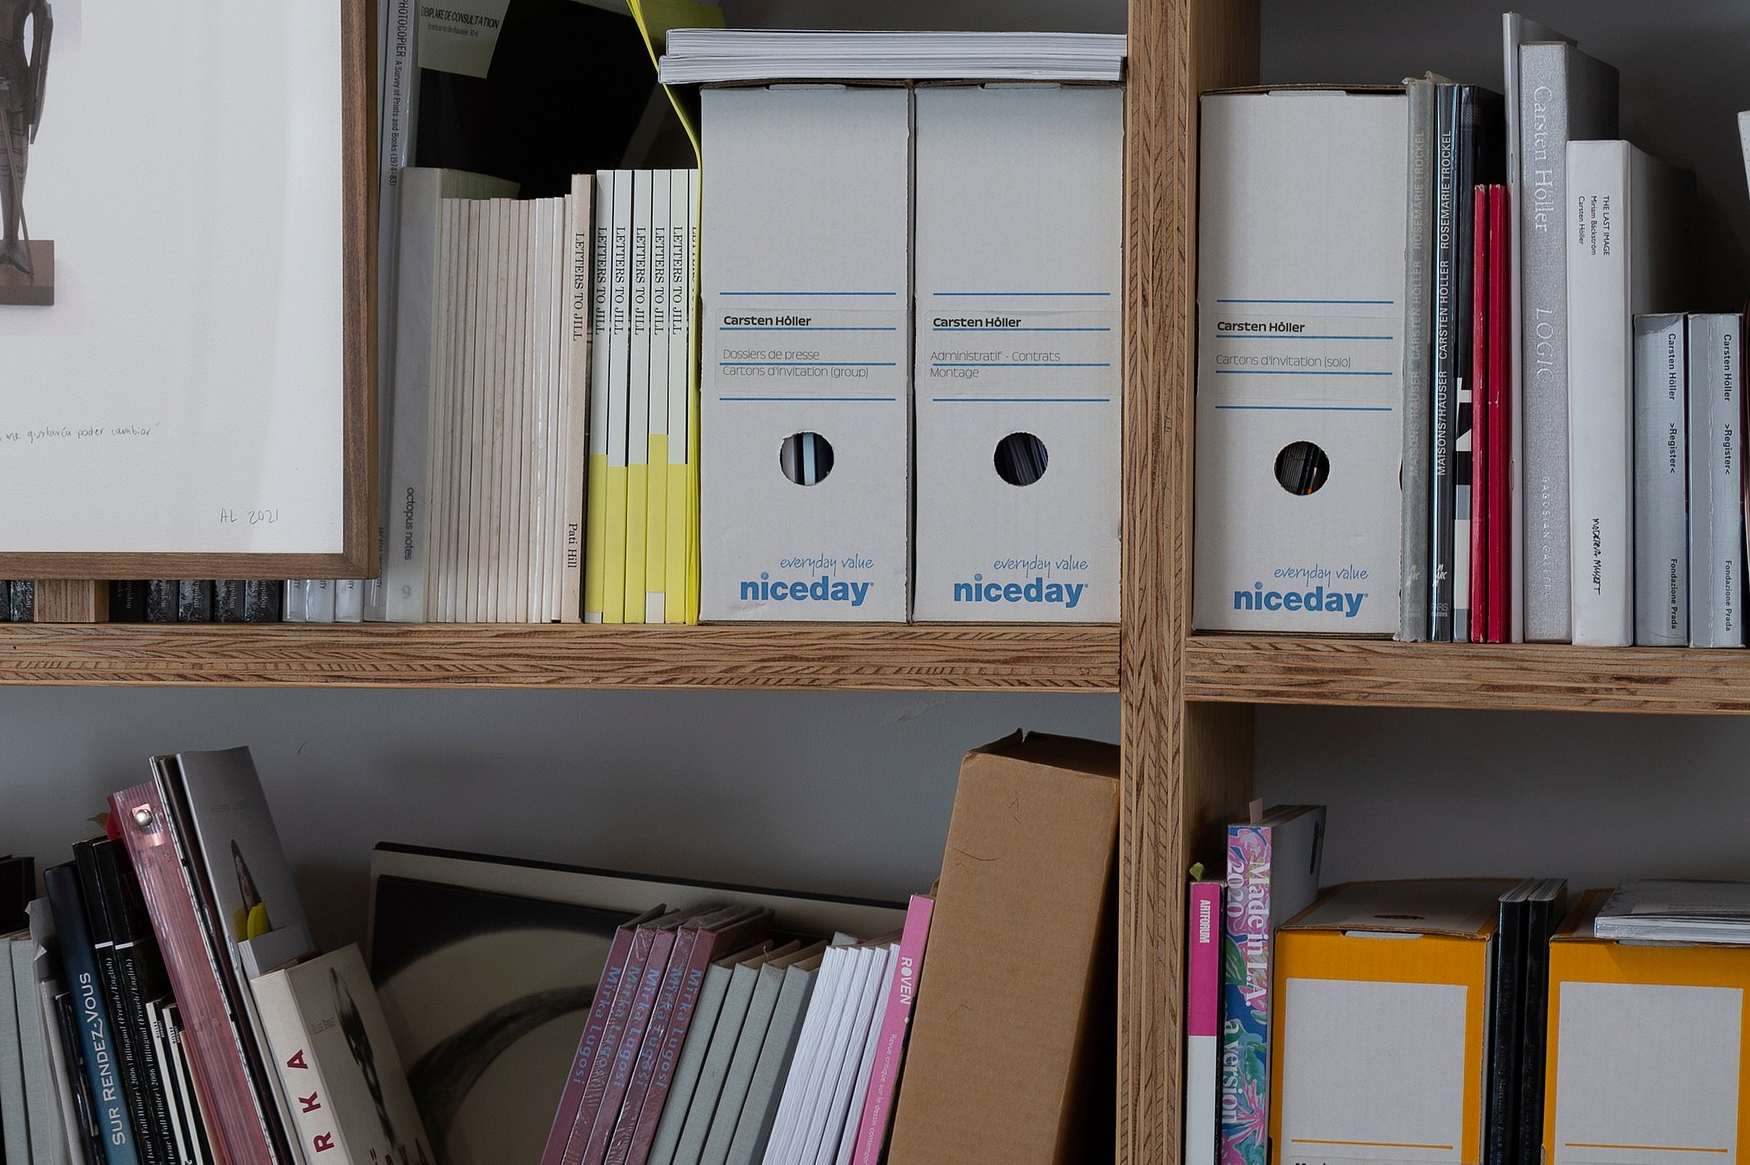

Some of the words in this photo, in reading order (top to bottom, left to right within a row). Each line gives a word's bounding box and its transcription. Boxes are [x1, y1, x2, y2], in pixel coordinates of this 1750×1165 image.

[1443, 129, 1453, 178] TROCKEL
[1440, 180, 1452, 250] ROSEMARIE
[573, 232, 585, 290] LETTERS
[1440, 260, 1449, 305] HÖLLER
[574, 293, 584, 310] TO
[724, 316, 773, 325] Carsten
[776, 316, 811, 326] Höller
[573, 313, 583, 341] JILL
[1439, 310, 1449, 360] CARSTEN
[1535, 306, 1555, 382] LOGIC
[1667, 334, 1676, 367] Carsten
[1667, 374, 1676, 401] Höller
[1438, 370, 1448, 476] MAISONS/HAUSER
[1669, 421, 1677, 475] >Register<
[405, 487, 414, 528] octopus
[404, 531, 412, 560] notes
[568, 523, 578, 544] Pati
[568, 549, 577, 568] Hill
[1669, 558, 1677, 602] Fondazione
[741, 572, 870, 606] niceday
[1669, 606, 1677, 630] Prada
[1227, 861, 1245, 918] 2020
[1248, 861, 1271, 928] Made
[1199, 899, 1211, 944] ARTFORUM
[1246, 934, 1269, 956] in
[1245, 961, 1268, 1007] L.A.
[80, 972, 116, 1103] RENDEZ-VOUS
[1222, 1039, 1243, 1123] version
[108, 1108, 126, 1146] SUR
